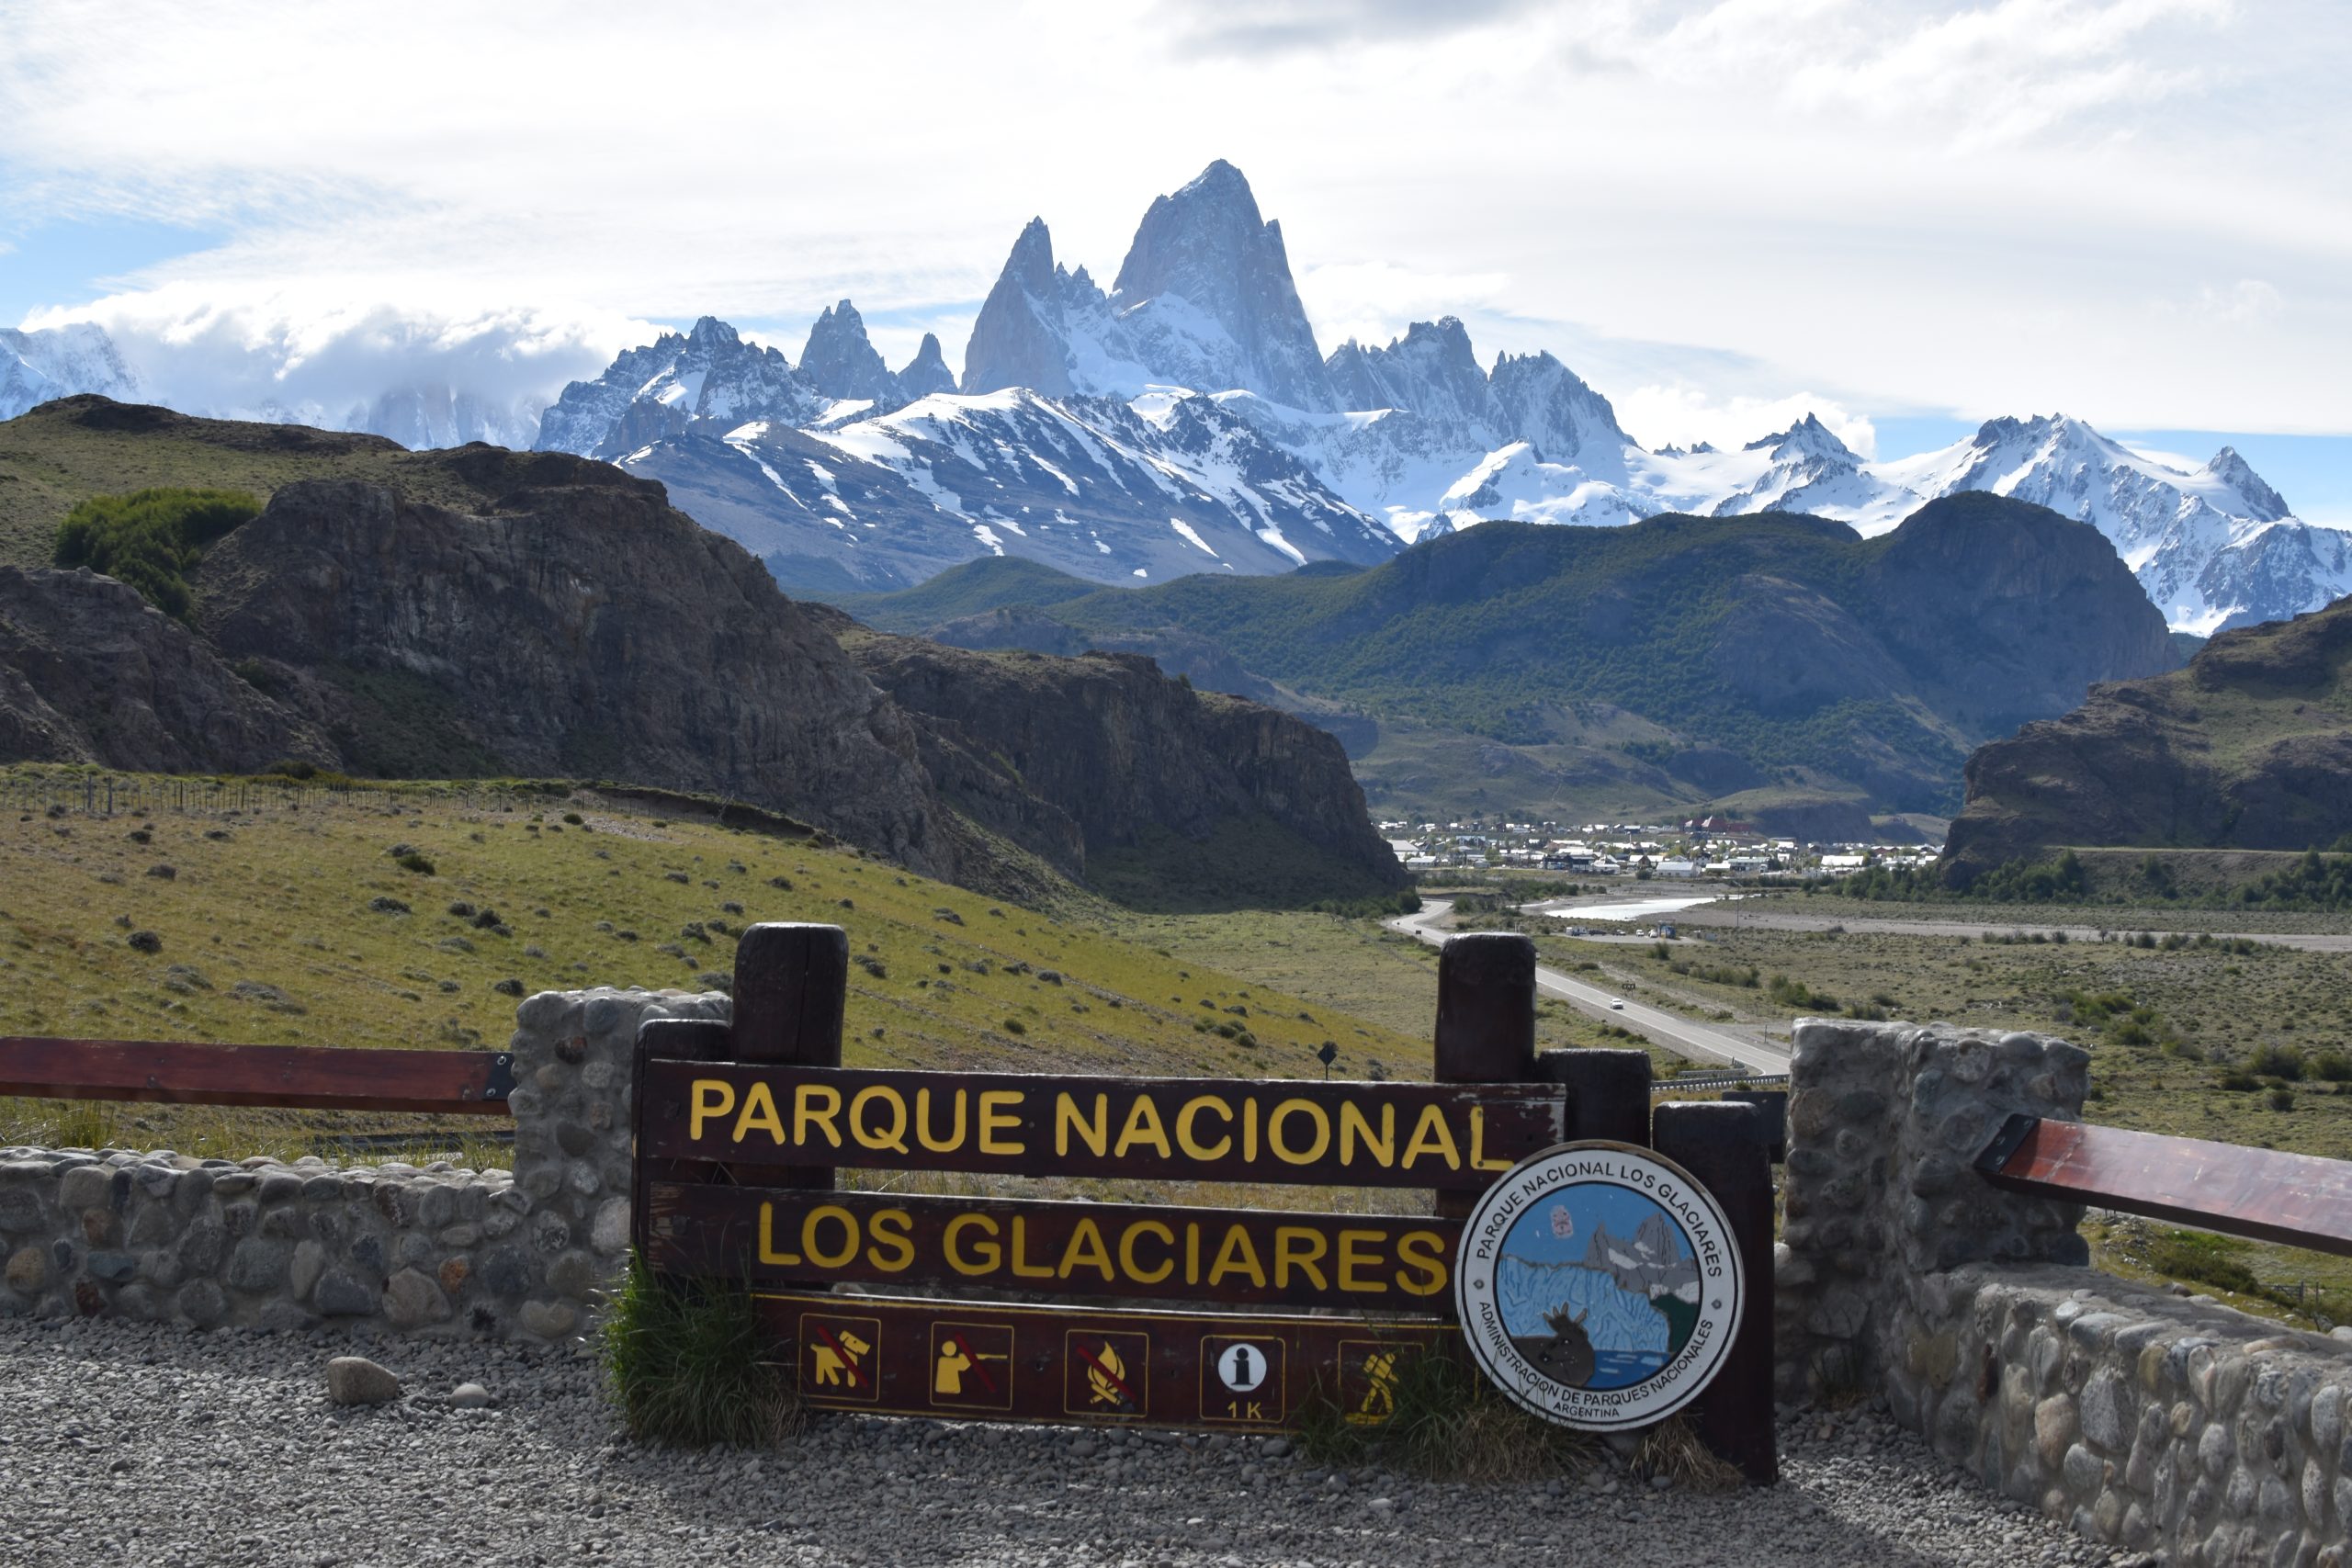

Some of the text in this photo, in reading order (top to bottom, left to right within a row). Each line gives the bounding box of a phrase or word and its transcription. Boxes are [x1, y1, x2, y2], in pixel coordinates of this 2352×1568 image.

[690, 1079, 1515, 1171] PARQUE NACIONAL
[759, 1201, 1448, 1296] LOS GLACIARES
[1476, 1162, 1722, 1278] PARQUE NACIONAL LOS GLACIARES
[1479, 1302, 1713, 1407] ADMINISTRACION DE PARQUES NACIONALES
[1227, 1401, 1261, 1419] 1 K
[1553, 1402, 1620, 1417] ARGENTINA
